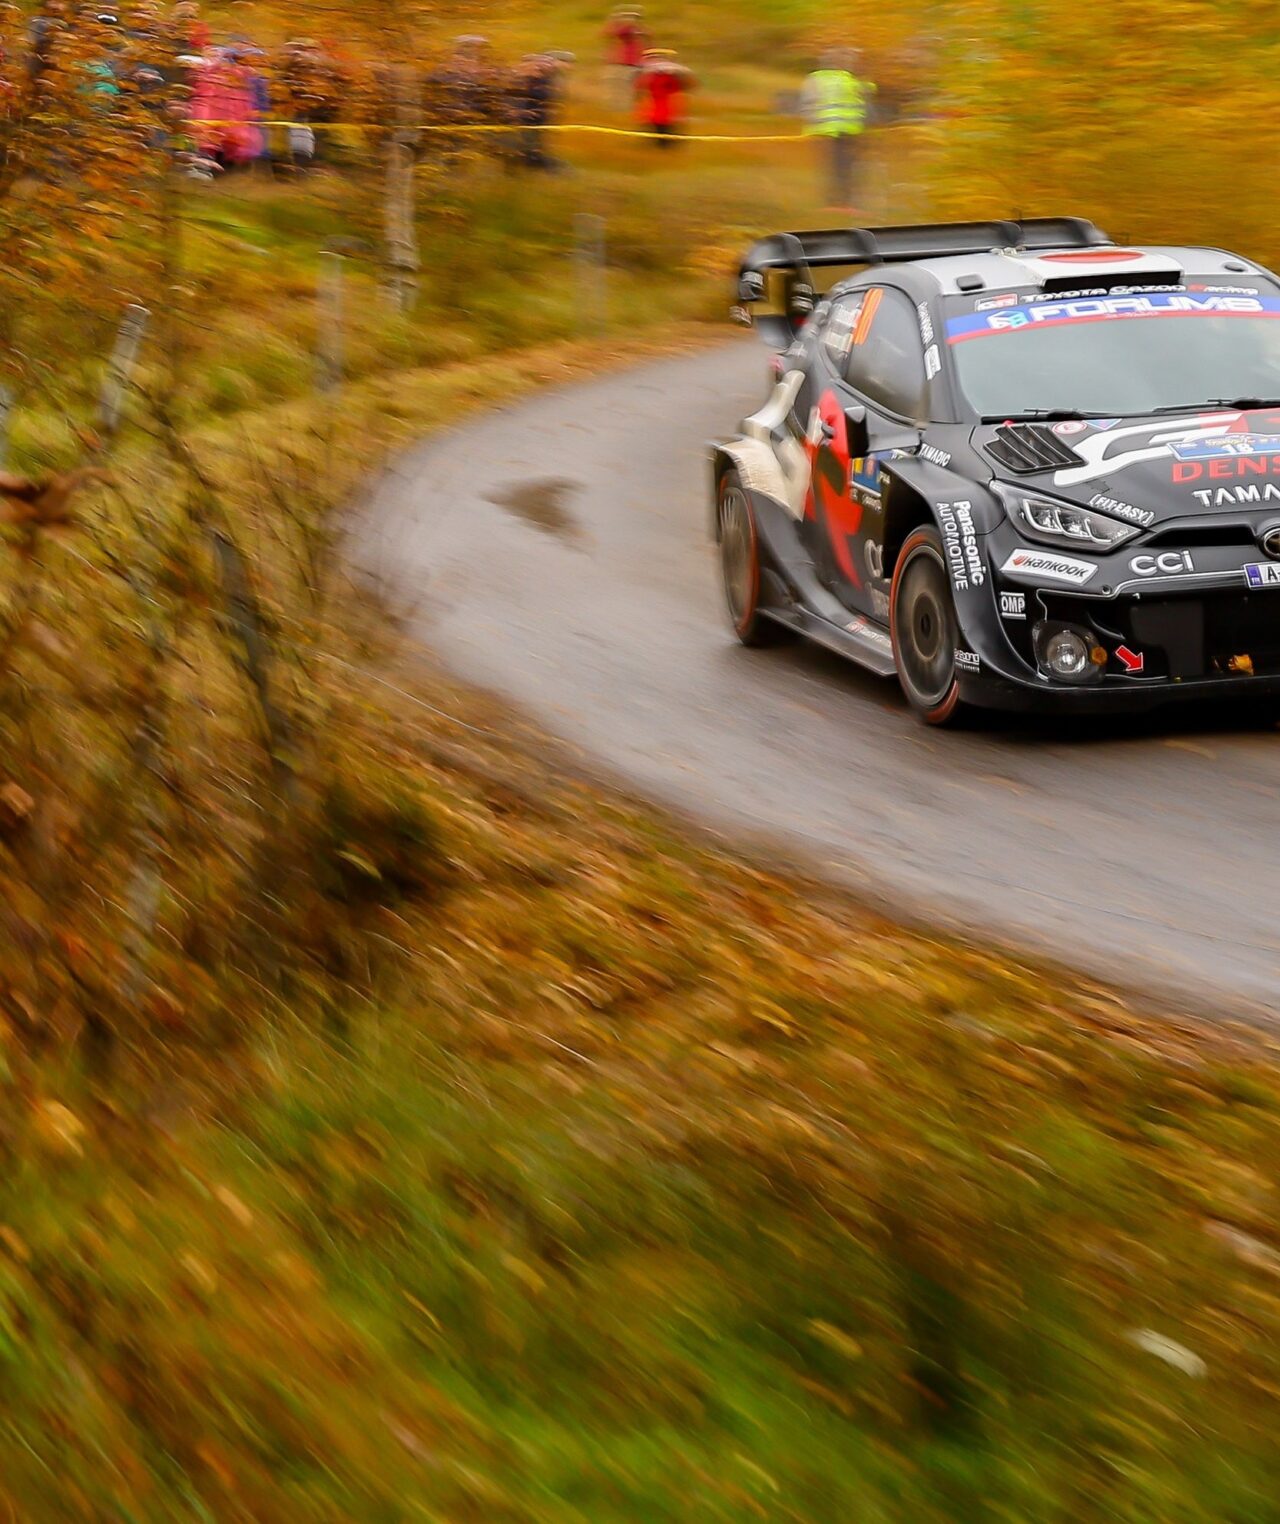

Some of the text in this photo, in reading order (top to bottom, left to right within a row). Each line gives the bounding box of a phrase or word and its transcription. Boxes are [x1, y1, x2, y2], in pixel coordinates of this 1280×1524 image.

[1021, 288, 1107, 303] TOYOTA
[1029, 297, 1264, 322] FORUM8
[919, 443, 951, 467] TAMADIC
[937, 502, 968, 591] AUTOMOTIVE
[953, 500, 984, 586] Panasonic
[1001, 595, 1026, 613] OMP
